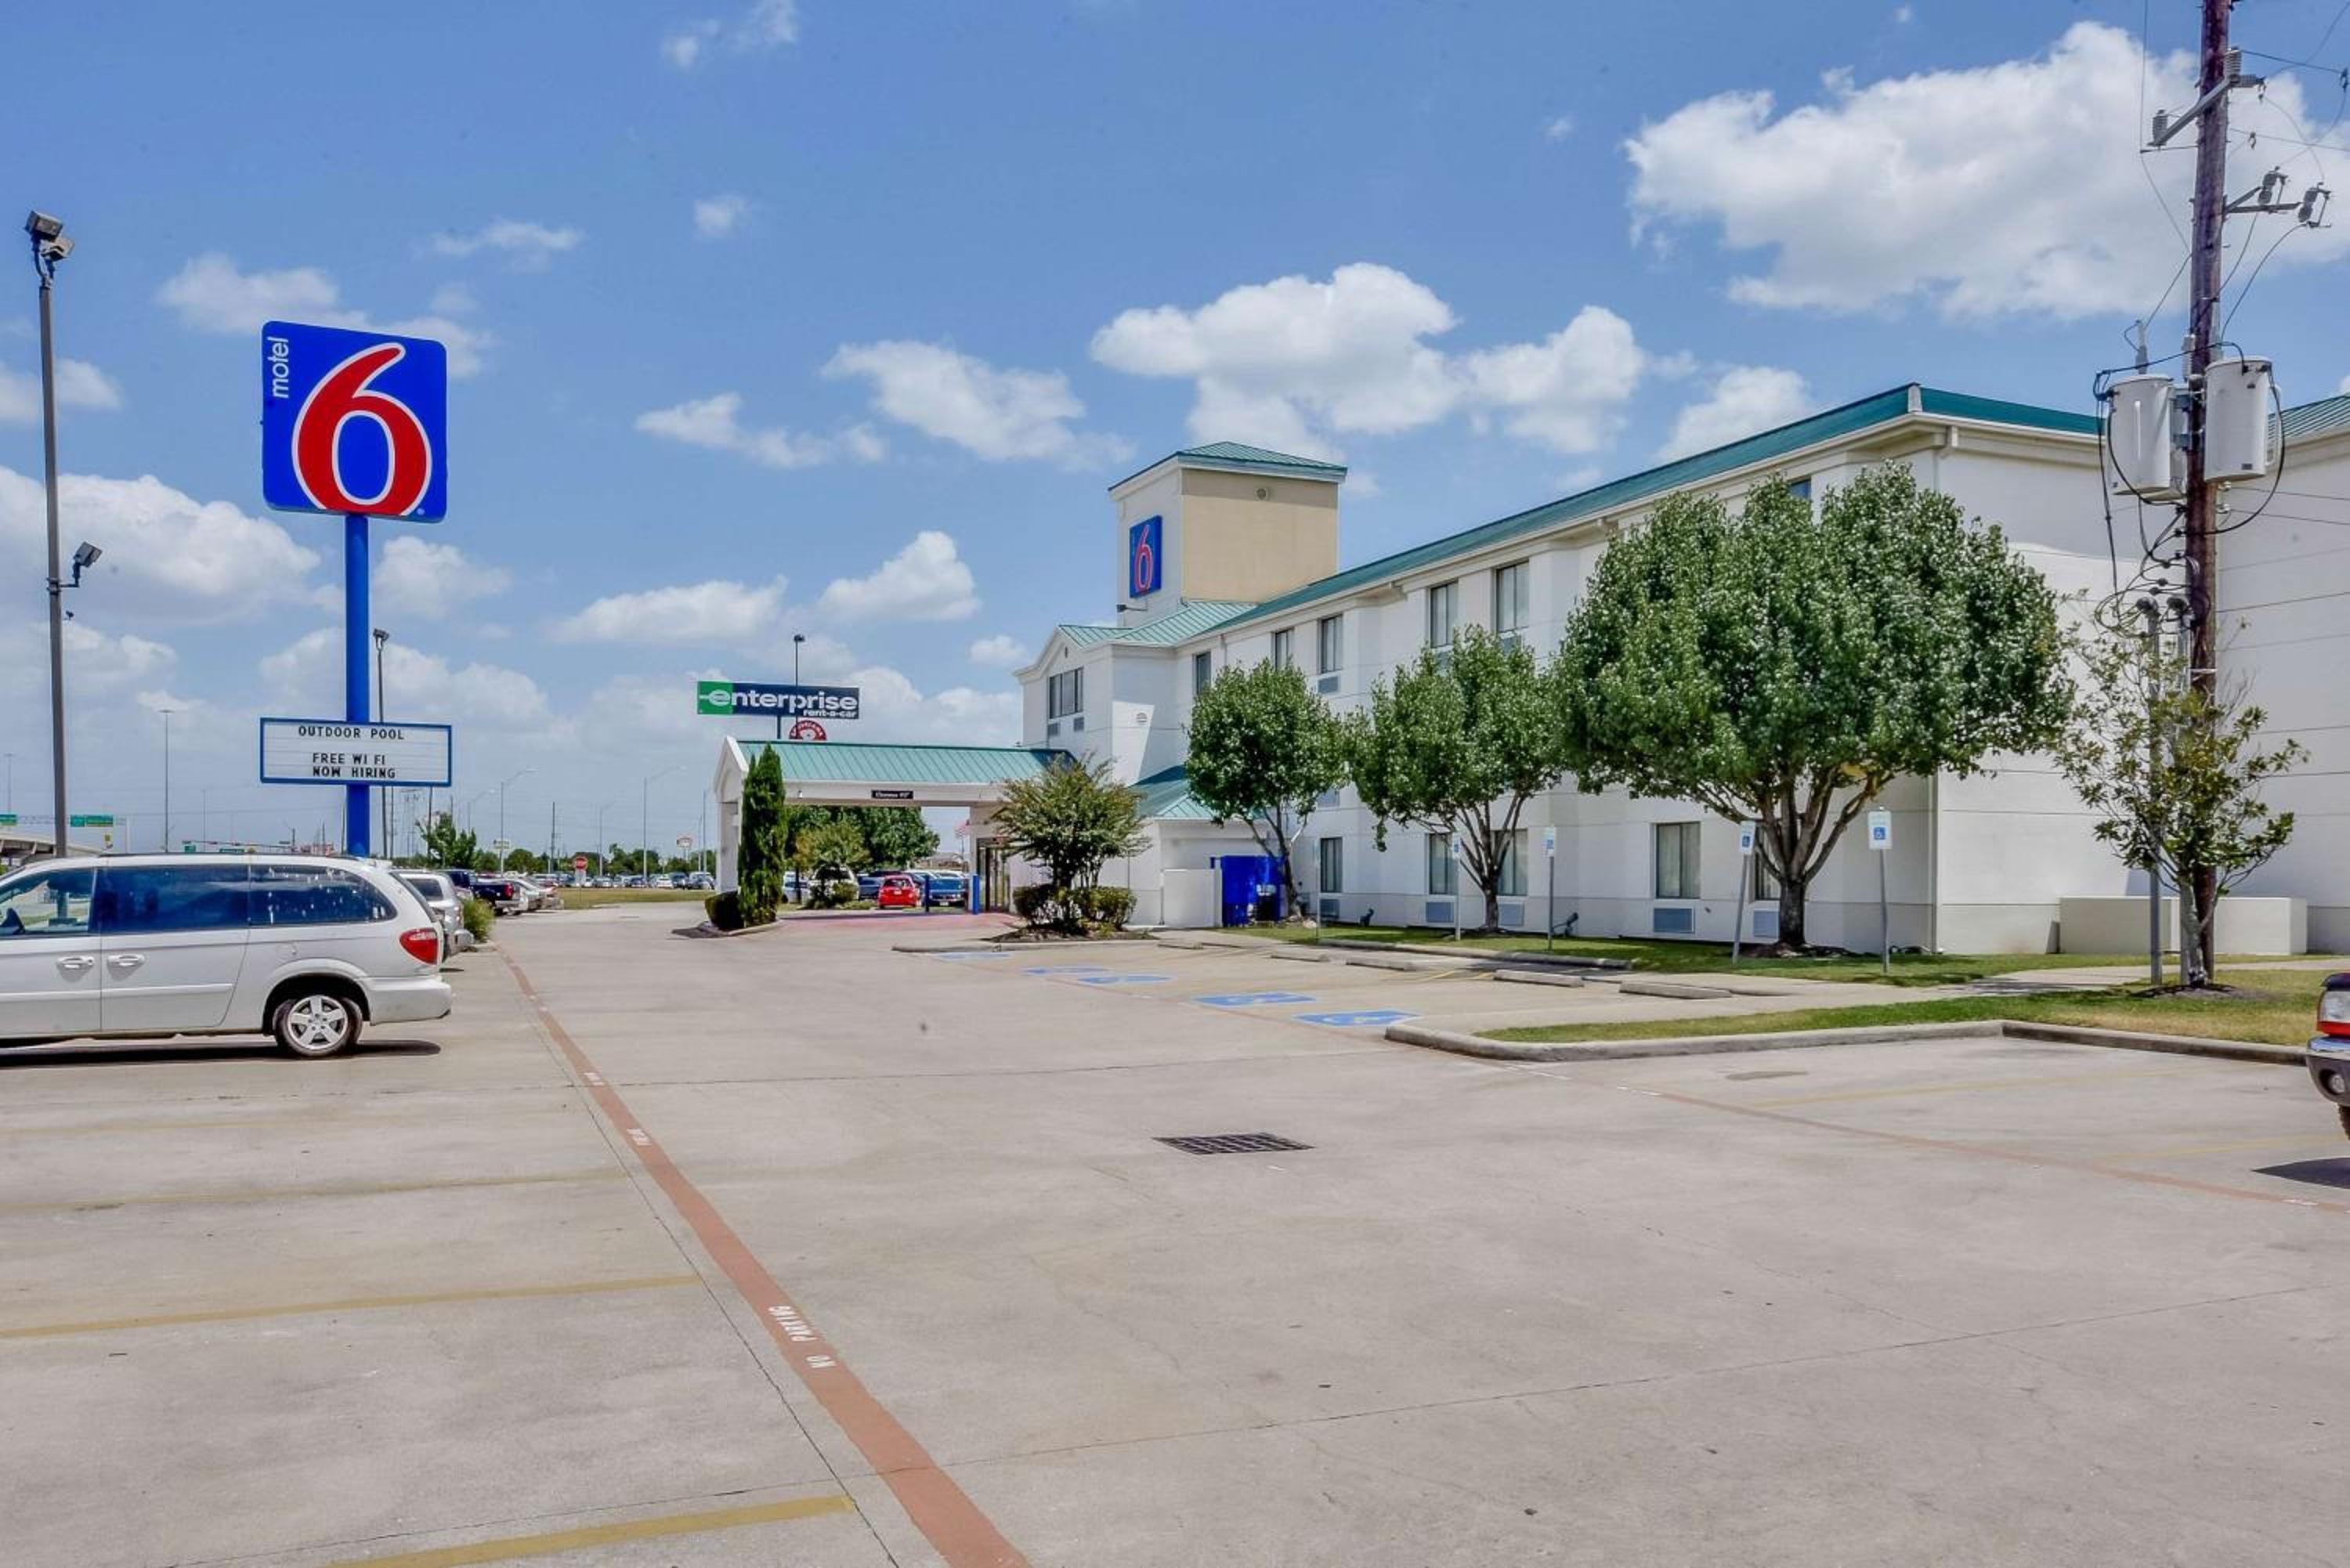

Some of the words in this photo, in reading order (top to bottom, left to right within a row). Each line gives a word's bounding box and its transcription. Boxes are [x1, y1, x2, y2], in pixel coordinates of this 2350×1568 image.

[267, 336, 289, 399] motel
[291, 342, 432, 516] 6
[1135, 525, 1153, 595] 6
[700, 690, 858, 714] enterprise
[298, 725, 361, 739] OUTDOOR
[371, 728, 404, 739] POOL
[313, 753, 345, 764] FREE
[313, 766, 341, 777] NOW
[352, 767, 396, 779] HIRING
